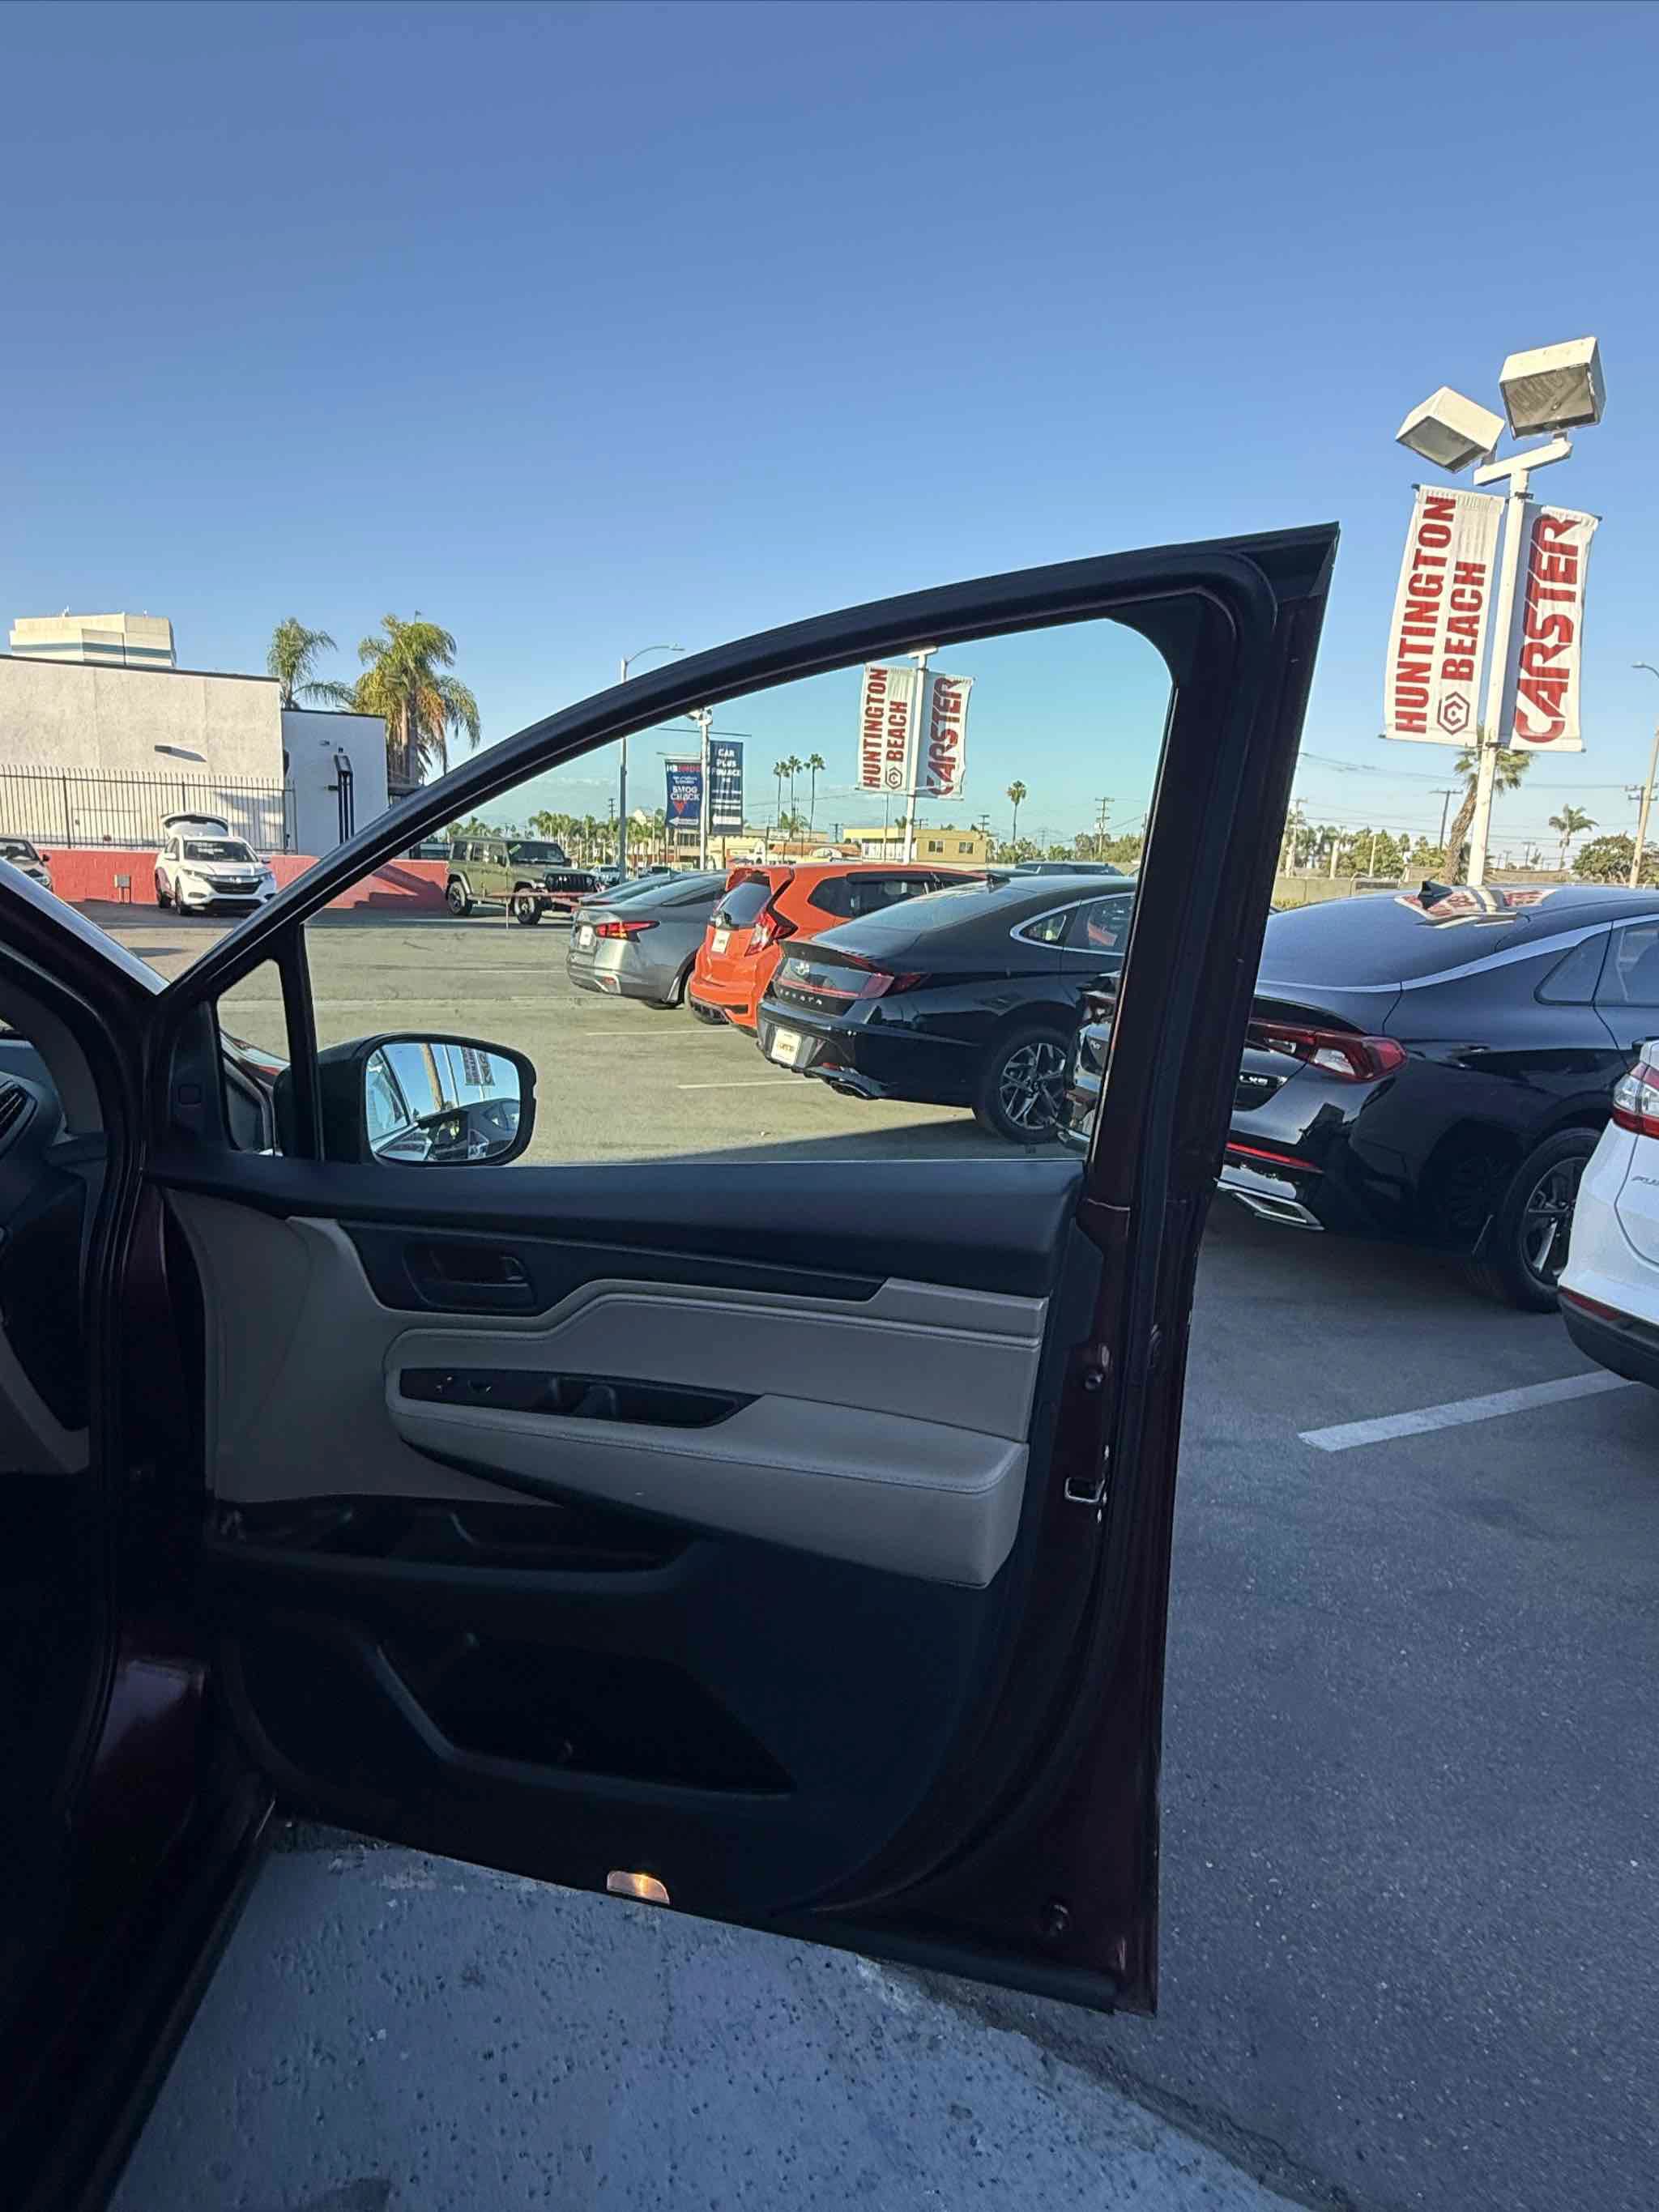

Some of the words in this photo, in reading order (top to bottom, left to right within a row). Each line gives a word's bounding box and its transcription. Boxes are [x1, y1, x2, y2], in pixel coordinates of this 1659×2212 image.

[1395, 495, 1456, 734] HUNTINGTON
[1441, 560, 1486, 682] BEACH
[1513, 514, 1582, 744] CARSTER
[718, 748, 735, 757] CAR
[863, 667, 888, 789] HUNTINGTON
[885, 700, 907, 763] BEACH
[926, 676, 962, 795] CARSTER
